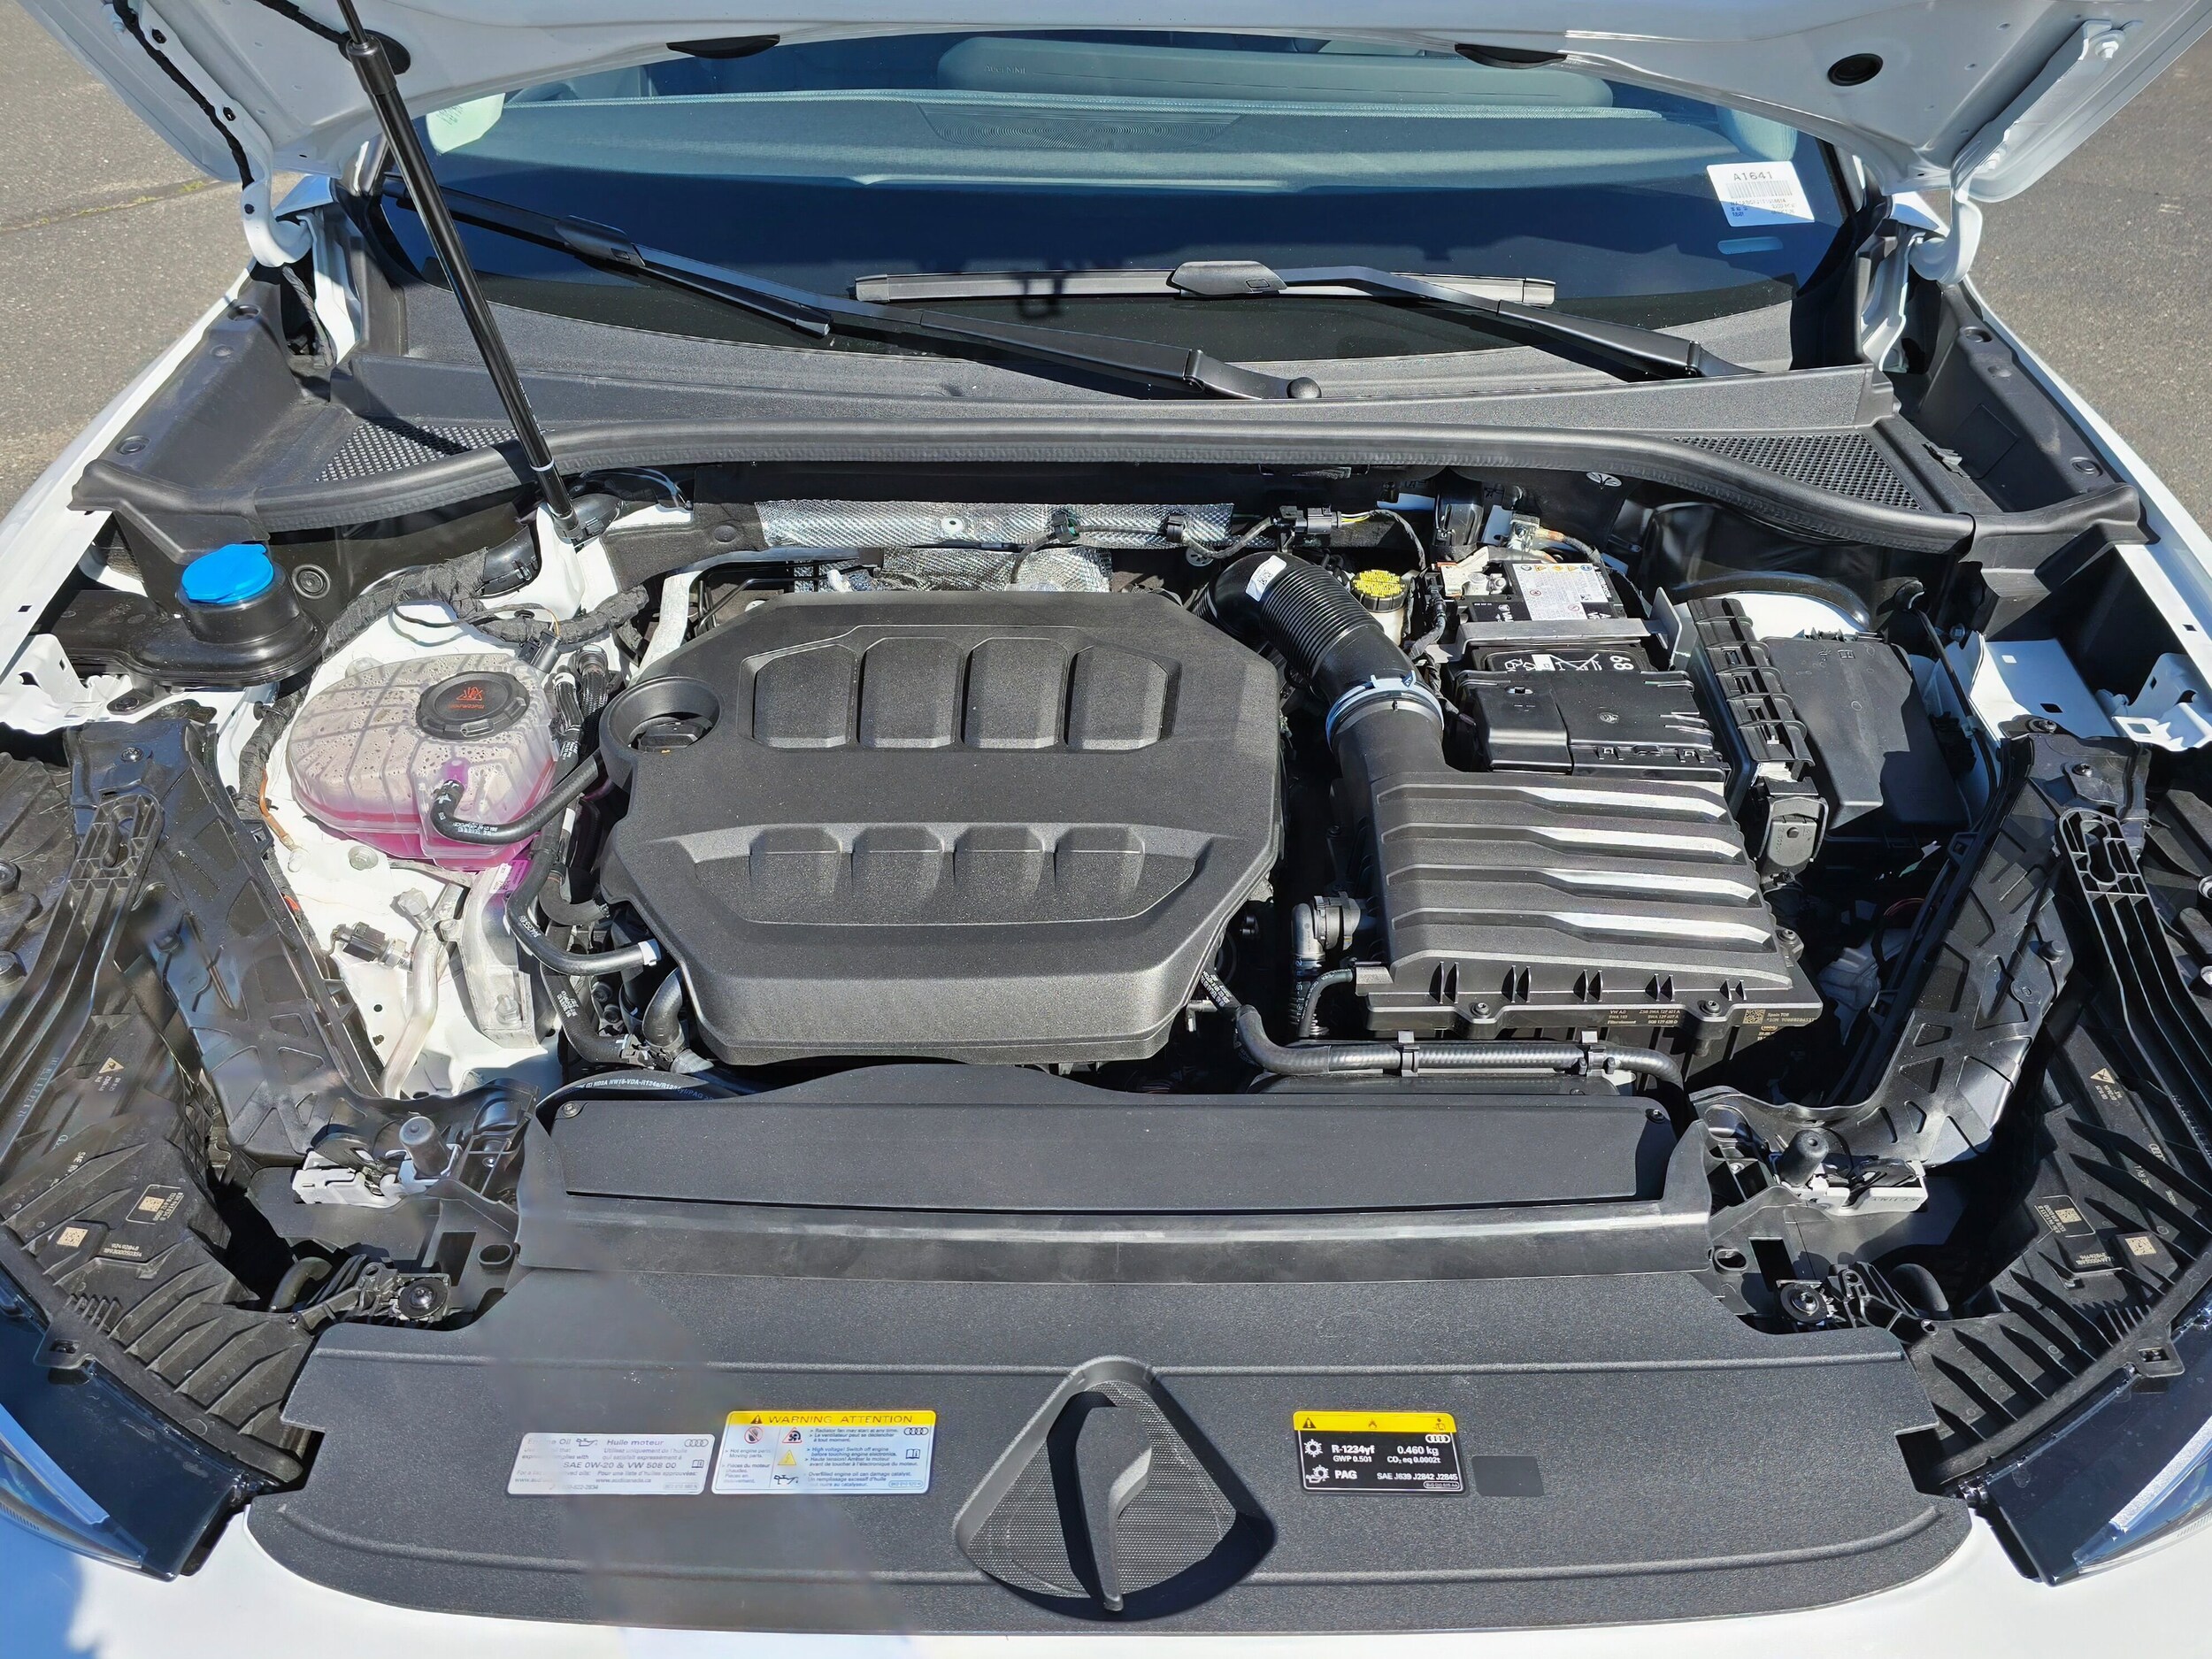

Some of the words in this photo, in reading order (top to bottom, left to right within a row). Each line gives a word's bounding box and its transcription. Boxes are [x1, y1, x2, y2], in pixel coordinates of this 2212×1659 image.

[1733, 172, 1773, 181] A1641
[1331, 1445, 1375, 1455] R-1234yf
[1396, 1446, 1425, 1455] 0.460
[1426, 1446, 1439, 1455] kg
[1334, 1470, 1357, 1479] PAG
